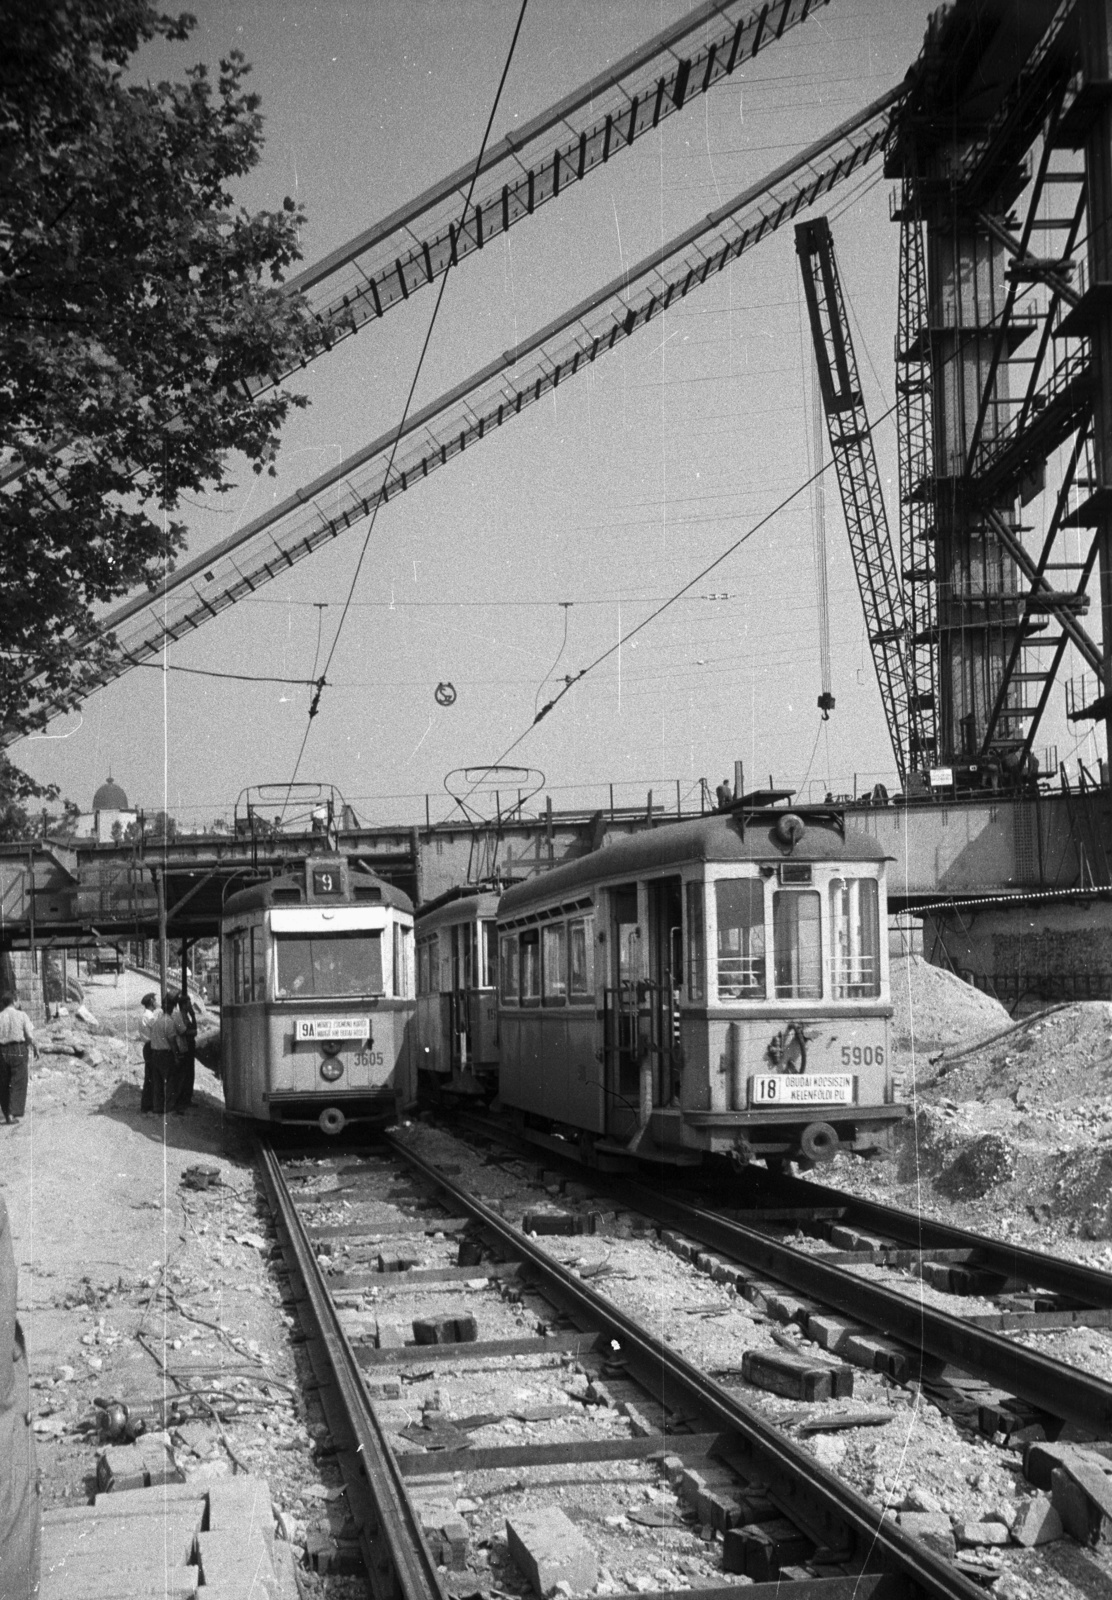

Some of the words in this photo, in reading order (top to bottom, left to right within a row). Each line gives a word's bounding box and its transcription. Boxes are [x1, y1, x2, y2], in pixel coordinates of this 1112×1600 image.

[321, 873, 333, 891] 9
[302, 1023, 315, 1037] 9A
[354, 1051, 384, 1067] 3605
[841, 1045, 884, 1066] 5906
[760, 1079, 776, 1099] 18
